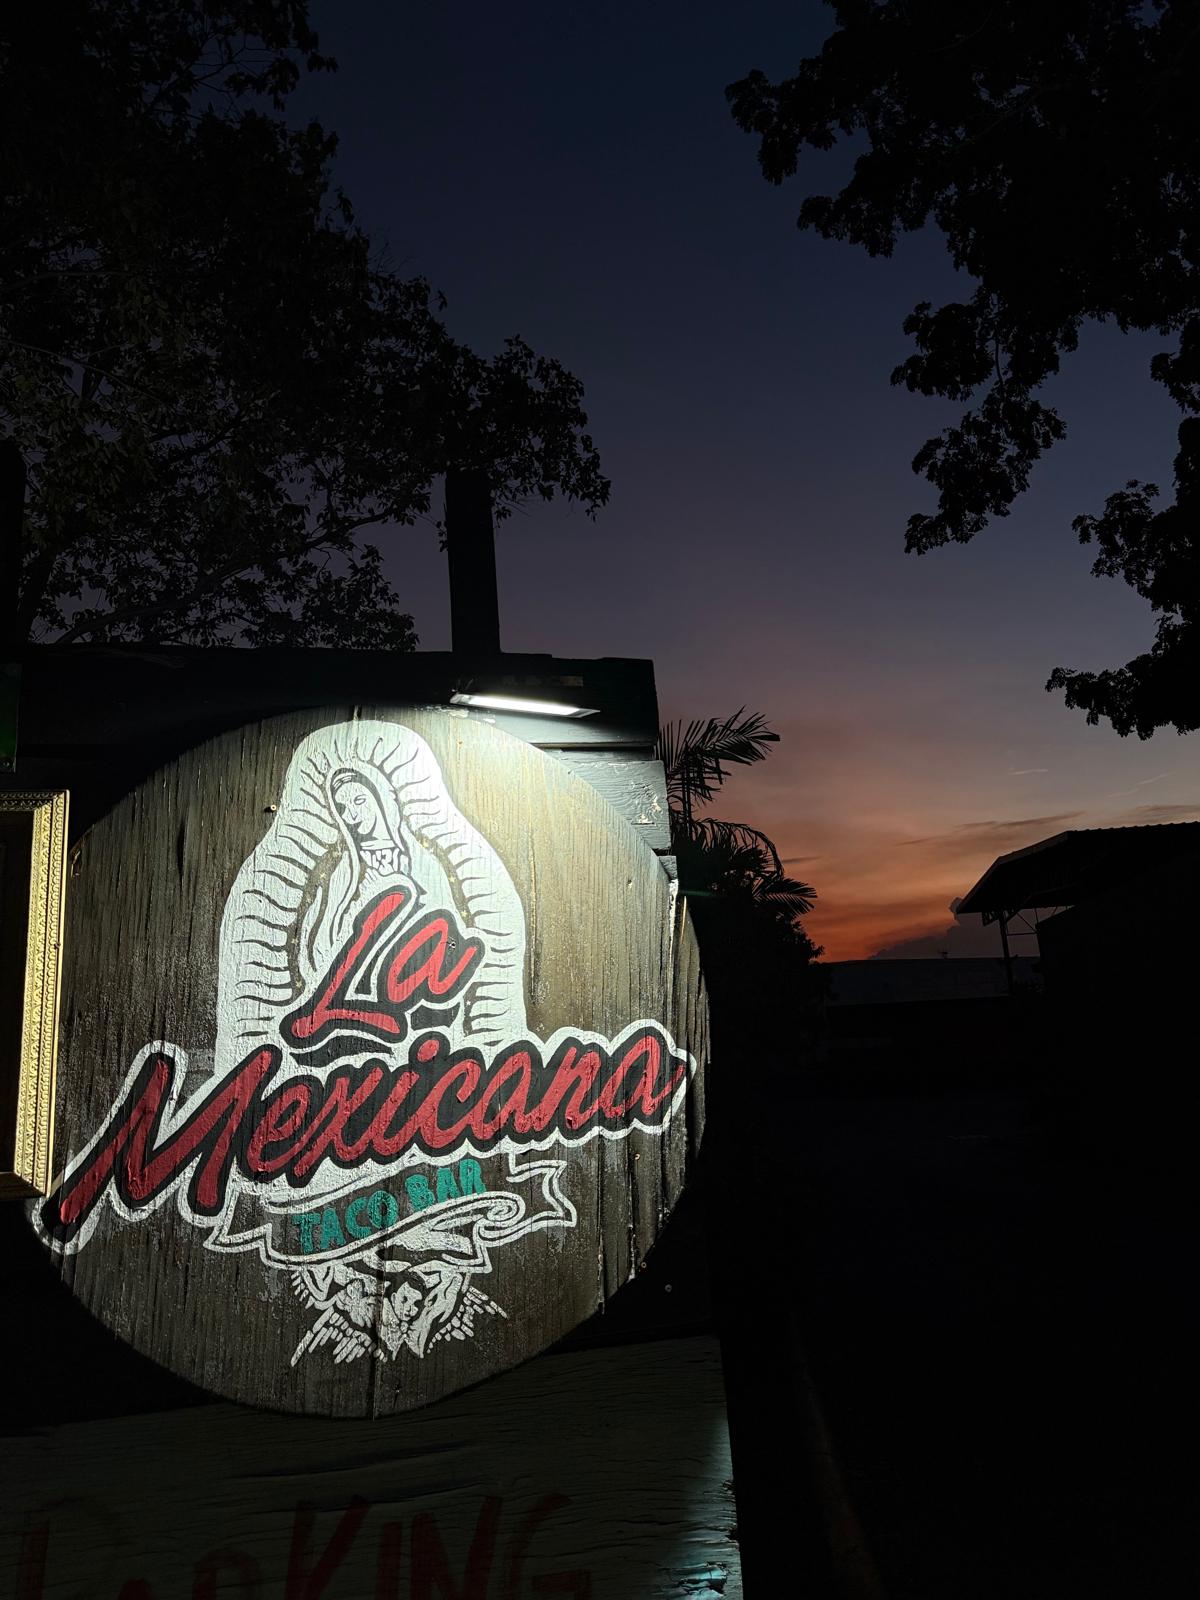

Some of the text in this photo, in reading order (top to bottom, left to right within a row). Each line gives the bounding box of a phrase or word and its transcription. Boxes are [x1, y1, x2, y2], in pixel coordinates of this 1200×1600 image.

[288, 889, 480, 1037] La
[54, 1031, 690, 1230] Mexicana
[291, 1158, 487, 1254] TACO BAR
[15, 1494, 593, 1600] PKING
